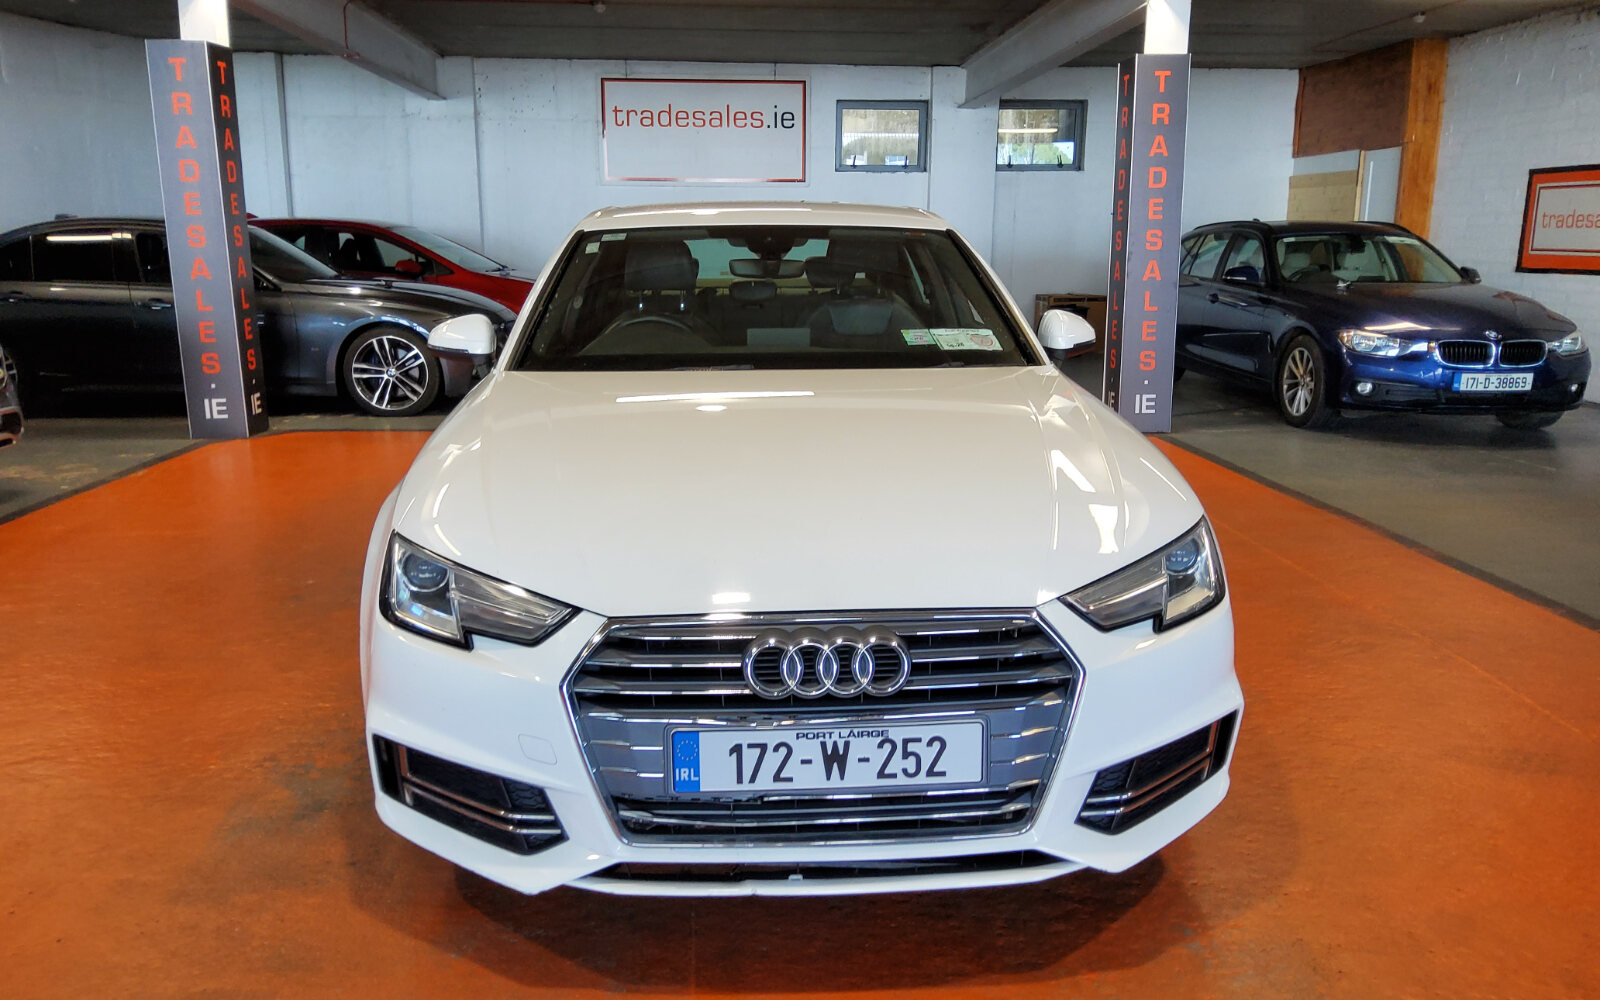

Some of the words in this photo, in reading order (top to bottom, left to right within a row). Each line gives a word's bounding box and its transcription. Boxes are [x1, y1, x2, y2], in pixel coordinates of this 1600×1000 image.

[612, 103, 796, 129] tradesales.ie
[1465, 376, 1528, 389] 171-D-38869
[795, 731, 835, 740] PORT
[728, 735, 948, 785] 172-W-252
[675, 768, 699, 781] IRL
